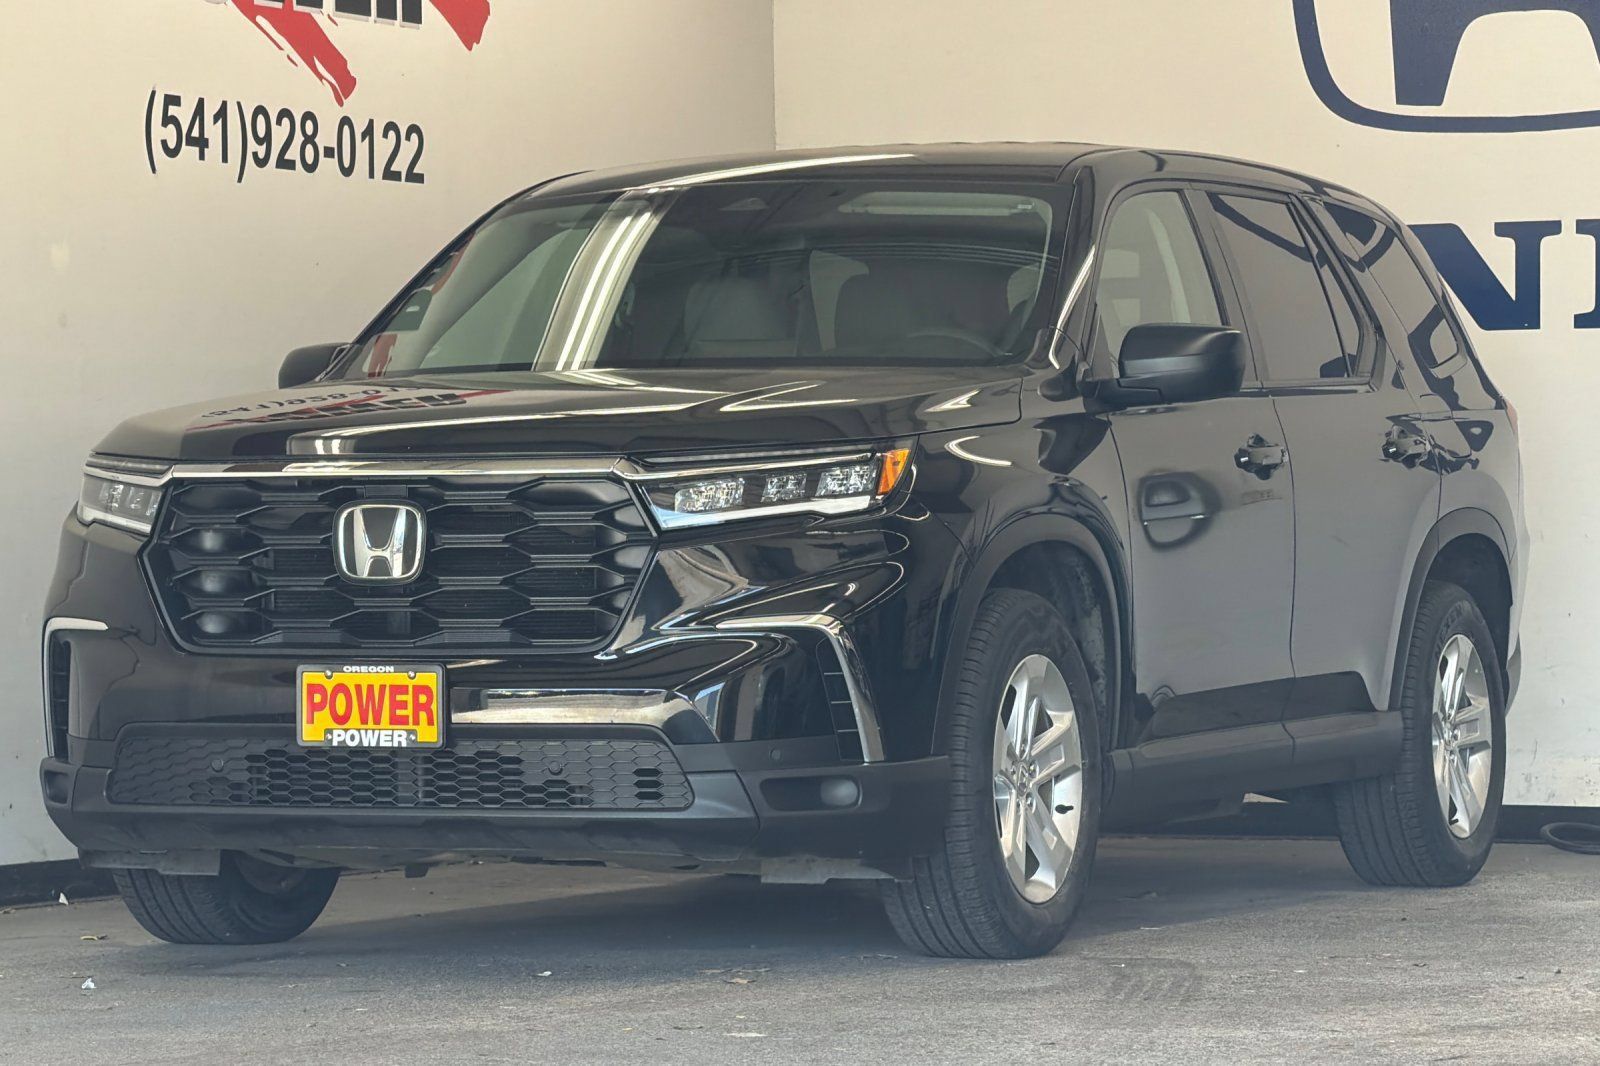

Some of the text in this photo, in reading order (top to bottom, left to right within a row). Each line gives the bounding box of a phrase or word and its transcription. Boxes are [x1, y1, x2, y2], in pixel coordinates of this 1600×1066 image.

[145, 89, 425, 184] (541)928-0122
[342, 665, 395, 673] OREGON
[306, 683, 435, 726] POWER
[332, 729, 408, 747] POWER
